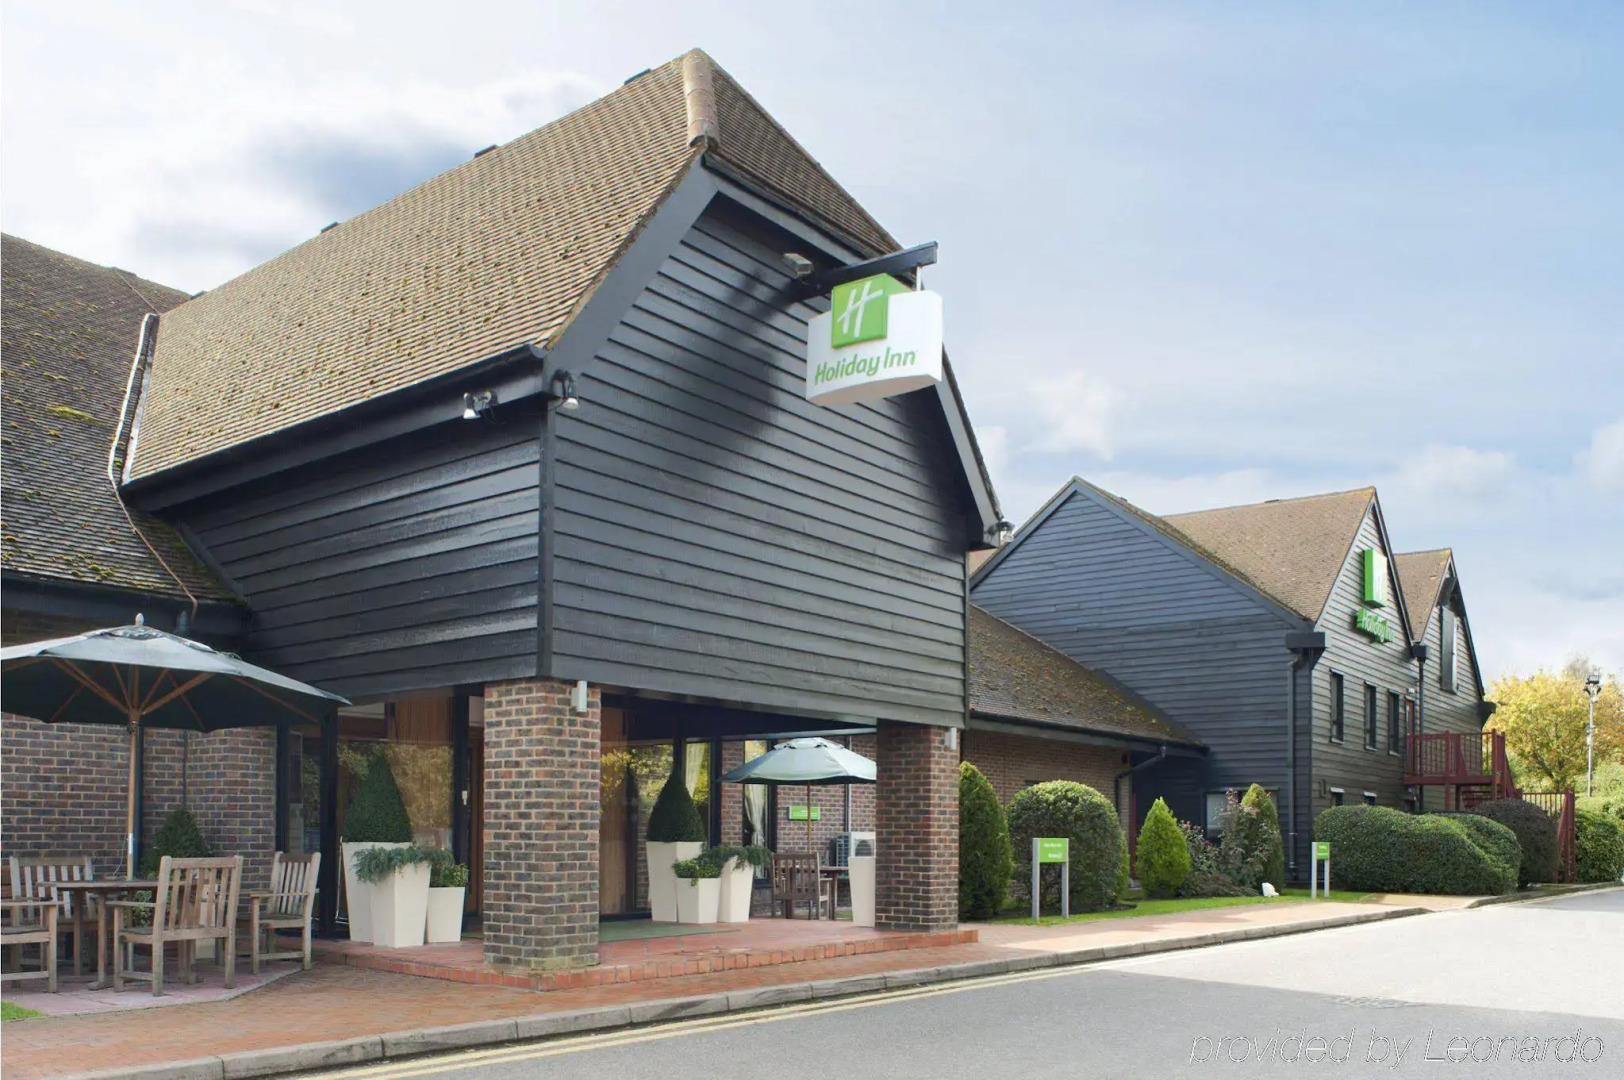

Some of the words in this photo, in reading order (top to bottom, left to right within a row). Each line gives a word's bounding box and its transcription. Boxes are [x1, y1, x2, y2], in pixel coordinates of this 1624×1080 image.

[838, 281, 884, 338] H
[815, 353, 881, 385] Holiday
[883, 347, 916, 369] Inn
[1359, 608, 1385, 643] Holiday
